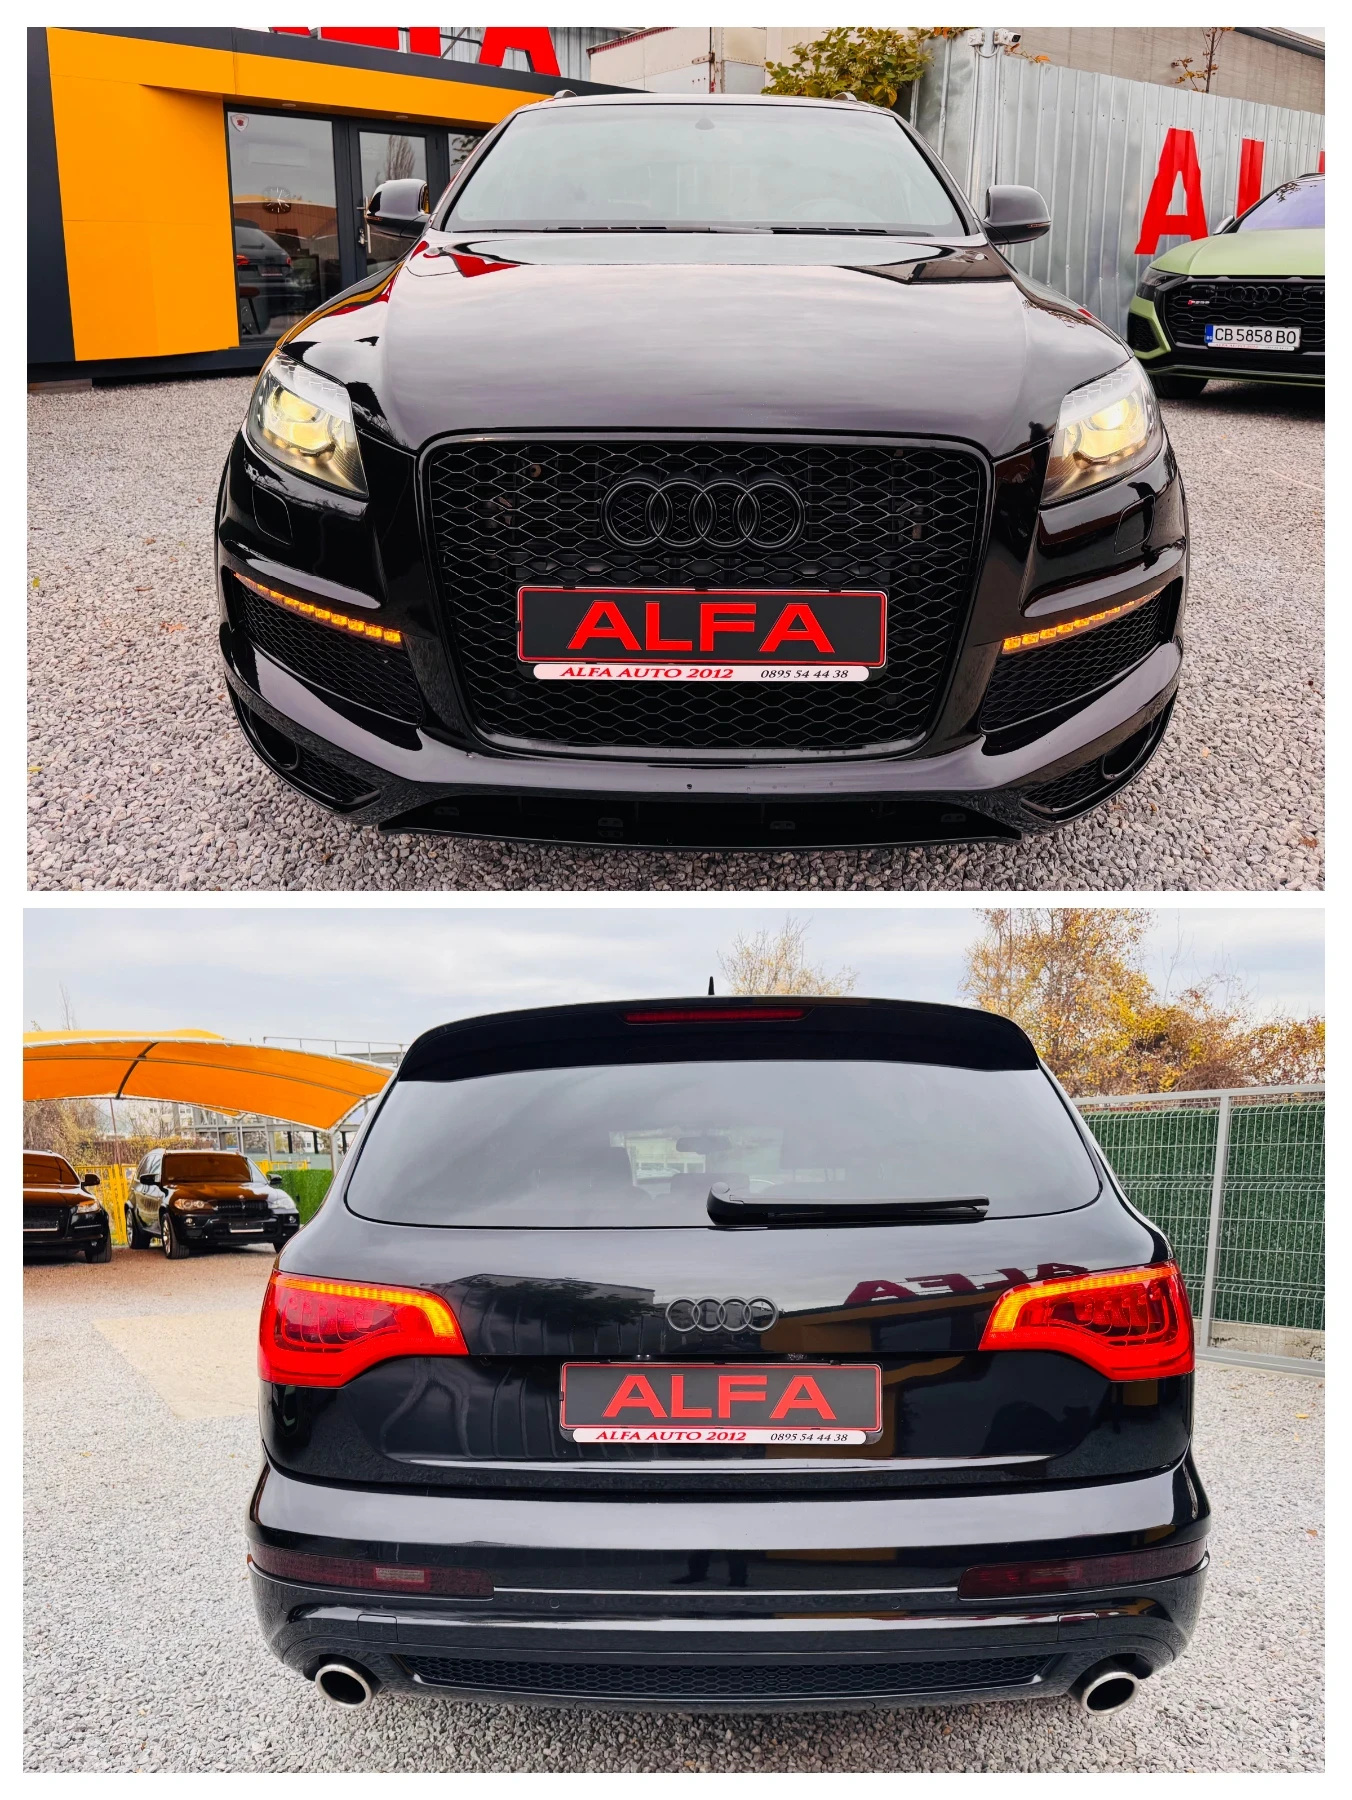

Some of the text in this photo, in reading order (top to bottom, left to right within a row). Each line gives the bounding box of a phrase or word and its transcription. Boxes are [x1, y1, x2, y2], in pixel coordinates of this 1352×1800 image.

[1215, 328, 1297, 344] CB 5858 BO
[566, 600, 836, 653] ALFA
[559, 667, 849, 679] ALFA AUTO 2012 0895 54 44 38
[601, 1374, 837, 1419] ALFA
[595, 1431, 849, 1442] ALFA AUTO 2012 0895 54 44 38
